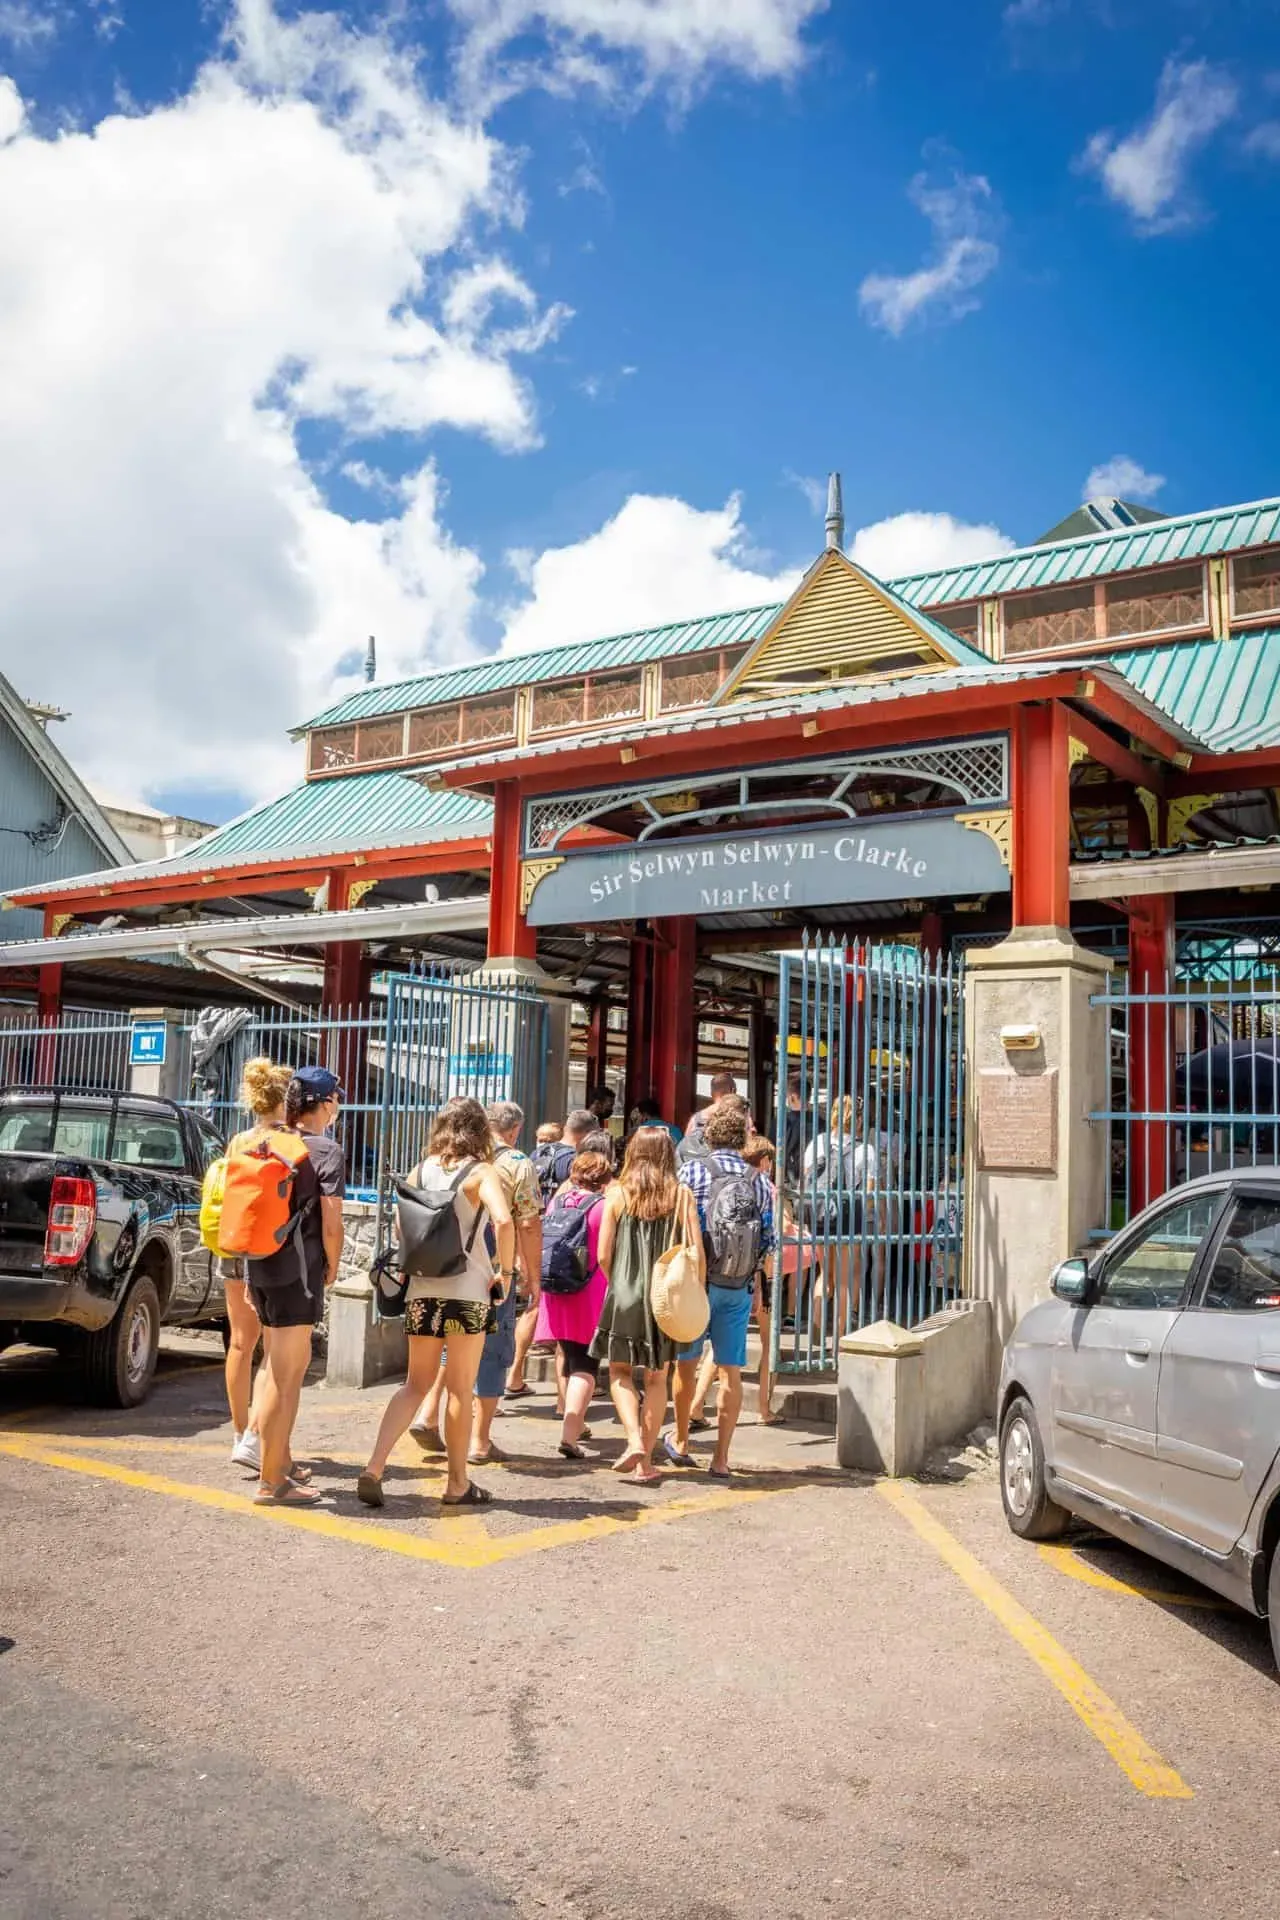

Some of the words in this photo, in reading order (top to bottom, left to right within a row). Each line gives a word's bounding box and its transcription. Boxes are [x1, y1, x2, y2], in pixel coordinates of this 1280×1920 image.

[589, 874, 623, 904] Sir
[628, 849, 715, 882] Selwyn
[723, 838, 928, 878] Selwyn-Clarke
[700, 880, 793, 906] Market
